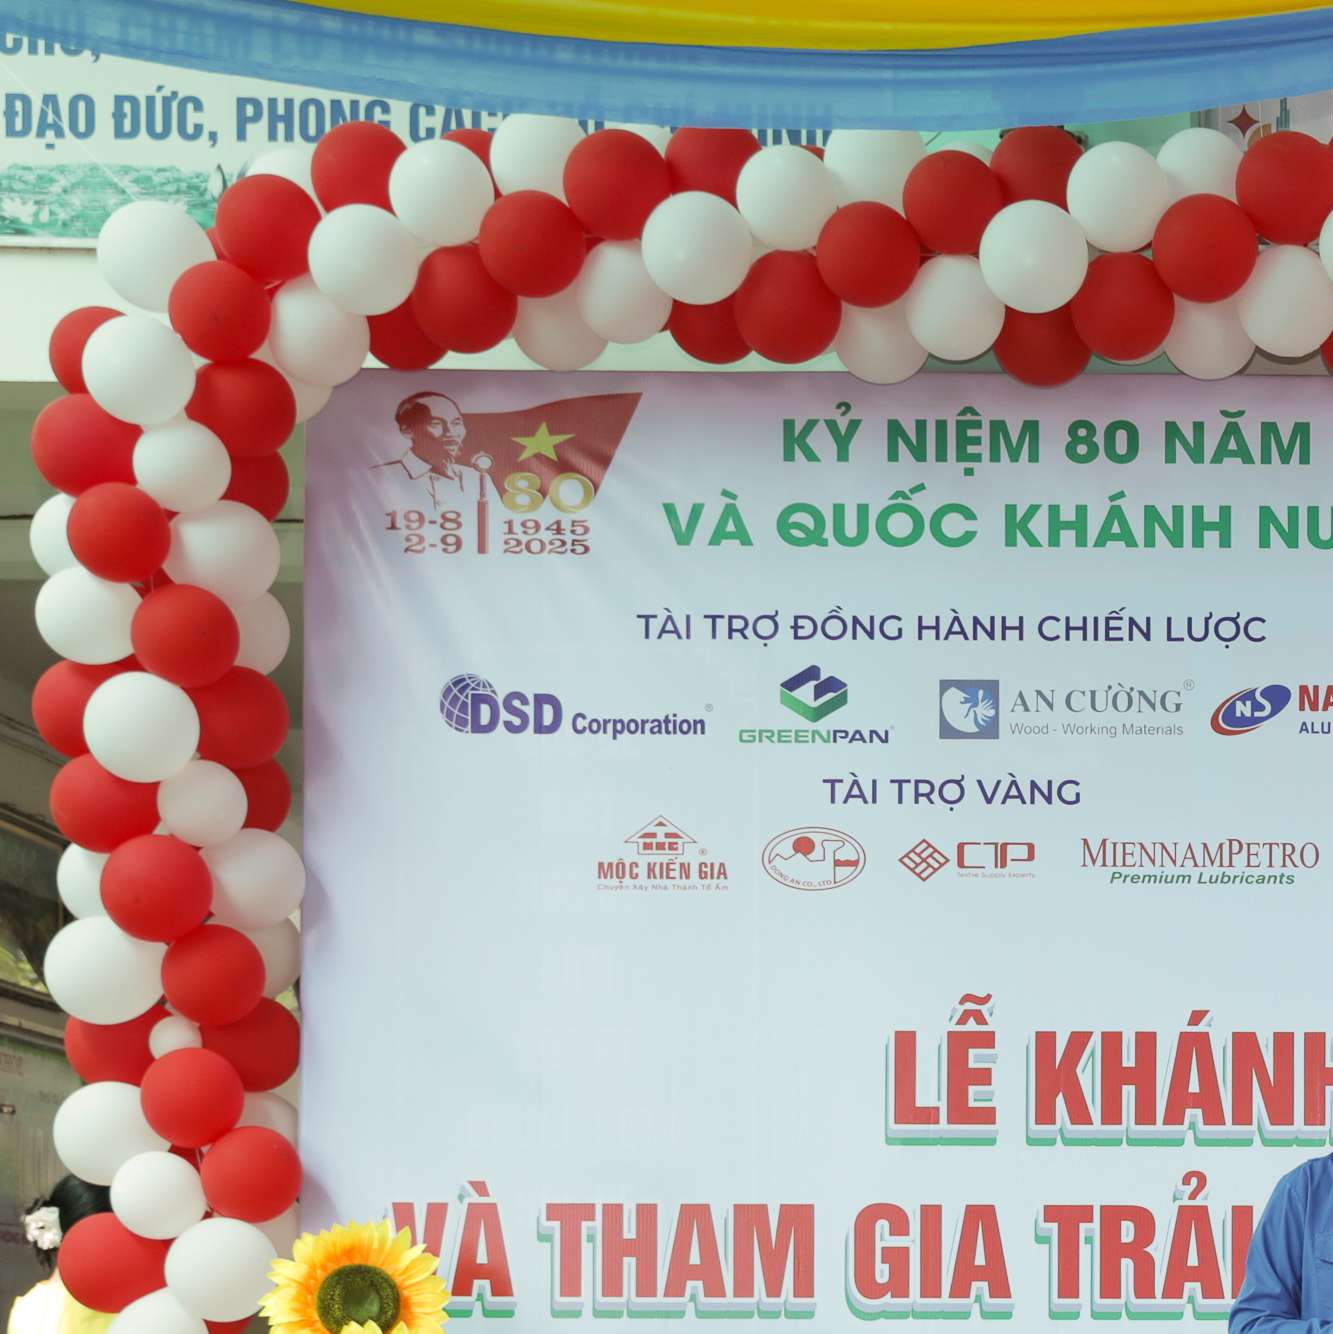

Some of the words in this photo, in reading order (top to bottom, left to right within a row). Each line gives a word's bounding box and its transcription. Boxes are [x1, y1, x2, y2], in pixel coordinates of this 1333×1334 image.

[3, 92, 97, 150] ĐẠO
[111, 84, 218, 148] ĐỨC,
[782, 403, 860, 464] KỶ
[887, 406, 1040, 476] NIỆM
[1065, 419, 1139, 464] 80
[1164, 409, 1311, 465] NĂM
[503, 472, 595, 514] 80
[384, 510, 462, 531] 19-8
[503, 518, 590, 536] 1945
[662, 488, 754, 546] VÀ
[776, 482, 978, 548] QUỐC
[1005, 490, 1231, 548] KHÁNH
[404, 533, 462, 555] 2-9
[503, 537, 590, 555] 2025
[636, 608, 691, 640] TÀI
[704, 610, 779, 647] TRỢ
[790, 606, 902, 640] ĐỒNG
[918, 609, 1024, 641] HÀNH
[1038, 607, 1151, 641] CHIẾN
[1167, 612, 1266, 649] LƯỢC
[470, 691, 563, 735] DSD
[571, 712, 706, 740] Corporation
[1010, 690, 1056, 713] AN
[1065, 683, 1184, 714] CƯỜNG
[738, 729, 889, 744] GREENPAN
[1010, 722, 1050, 736] Wood
[1061, 722, 1117, 738] Working
[1122, 722, 1184, 736] Materials
[822, 772, 877, 804] TÀI
[890, 774, 965, 811] TRỢ
[976, 773, 1080, 805] VÀNG
[698, 861, 728, 880] GIA
[1109, 871, 1192, 885] Premium
[1197, 871, 1296, 885] Lubricants
[894, 993, 996, 1125] LỄ
[546, 1204, 813, 1297] THAM
[854, 1204, 1011, 1298] GIA
[1044, 1170, 1254, 1298] TRẢI
